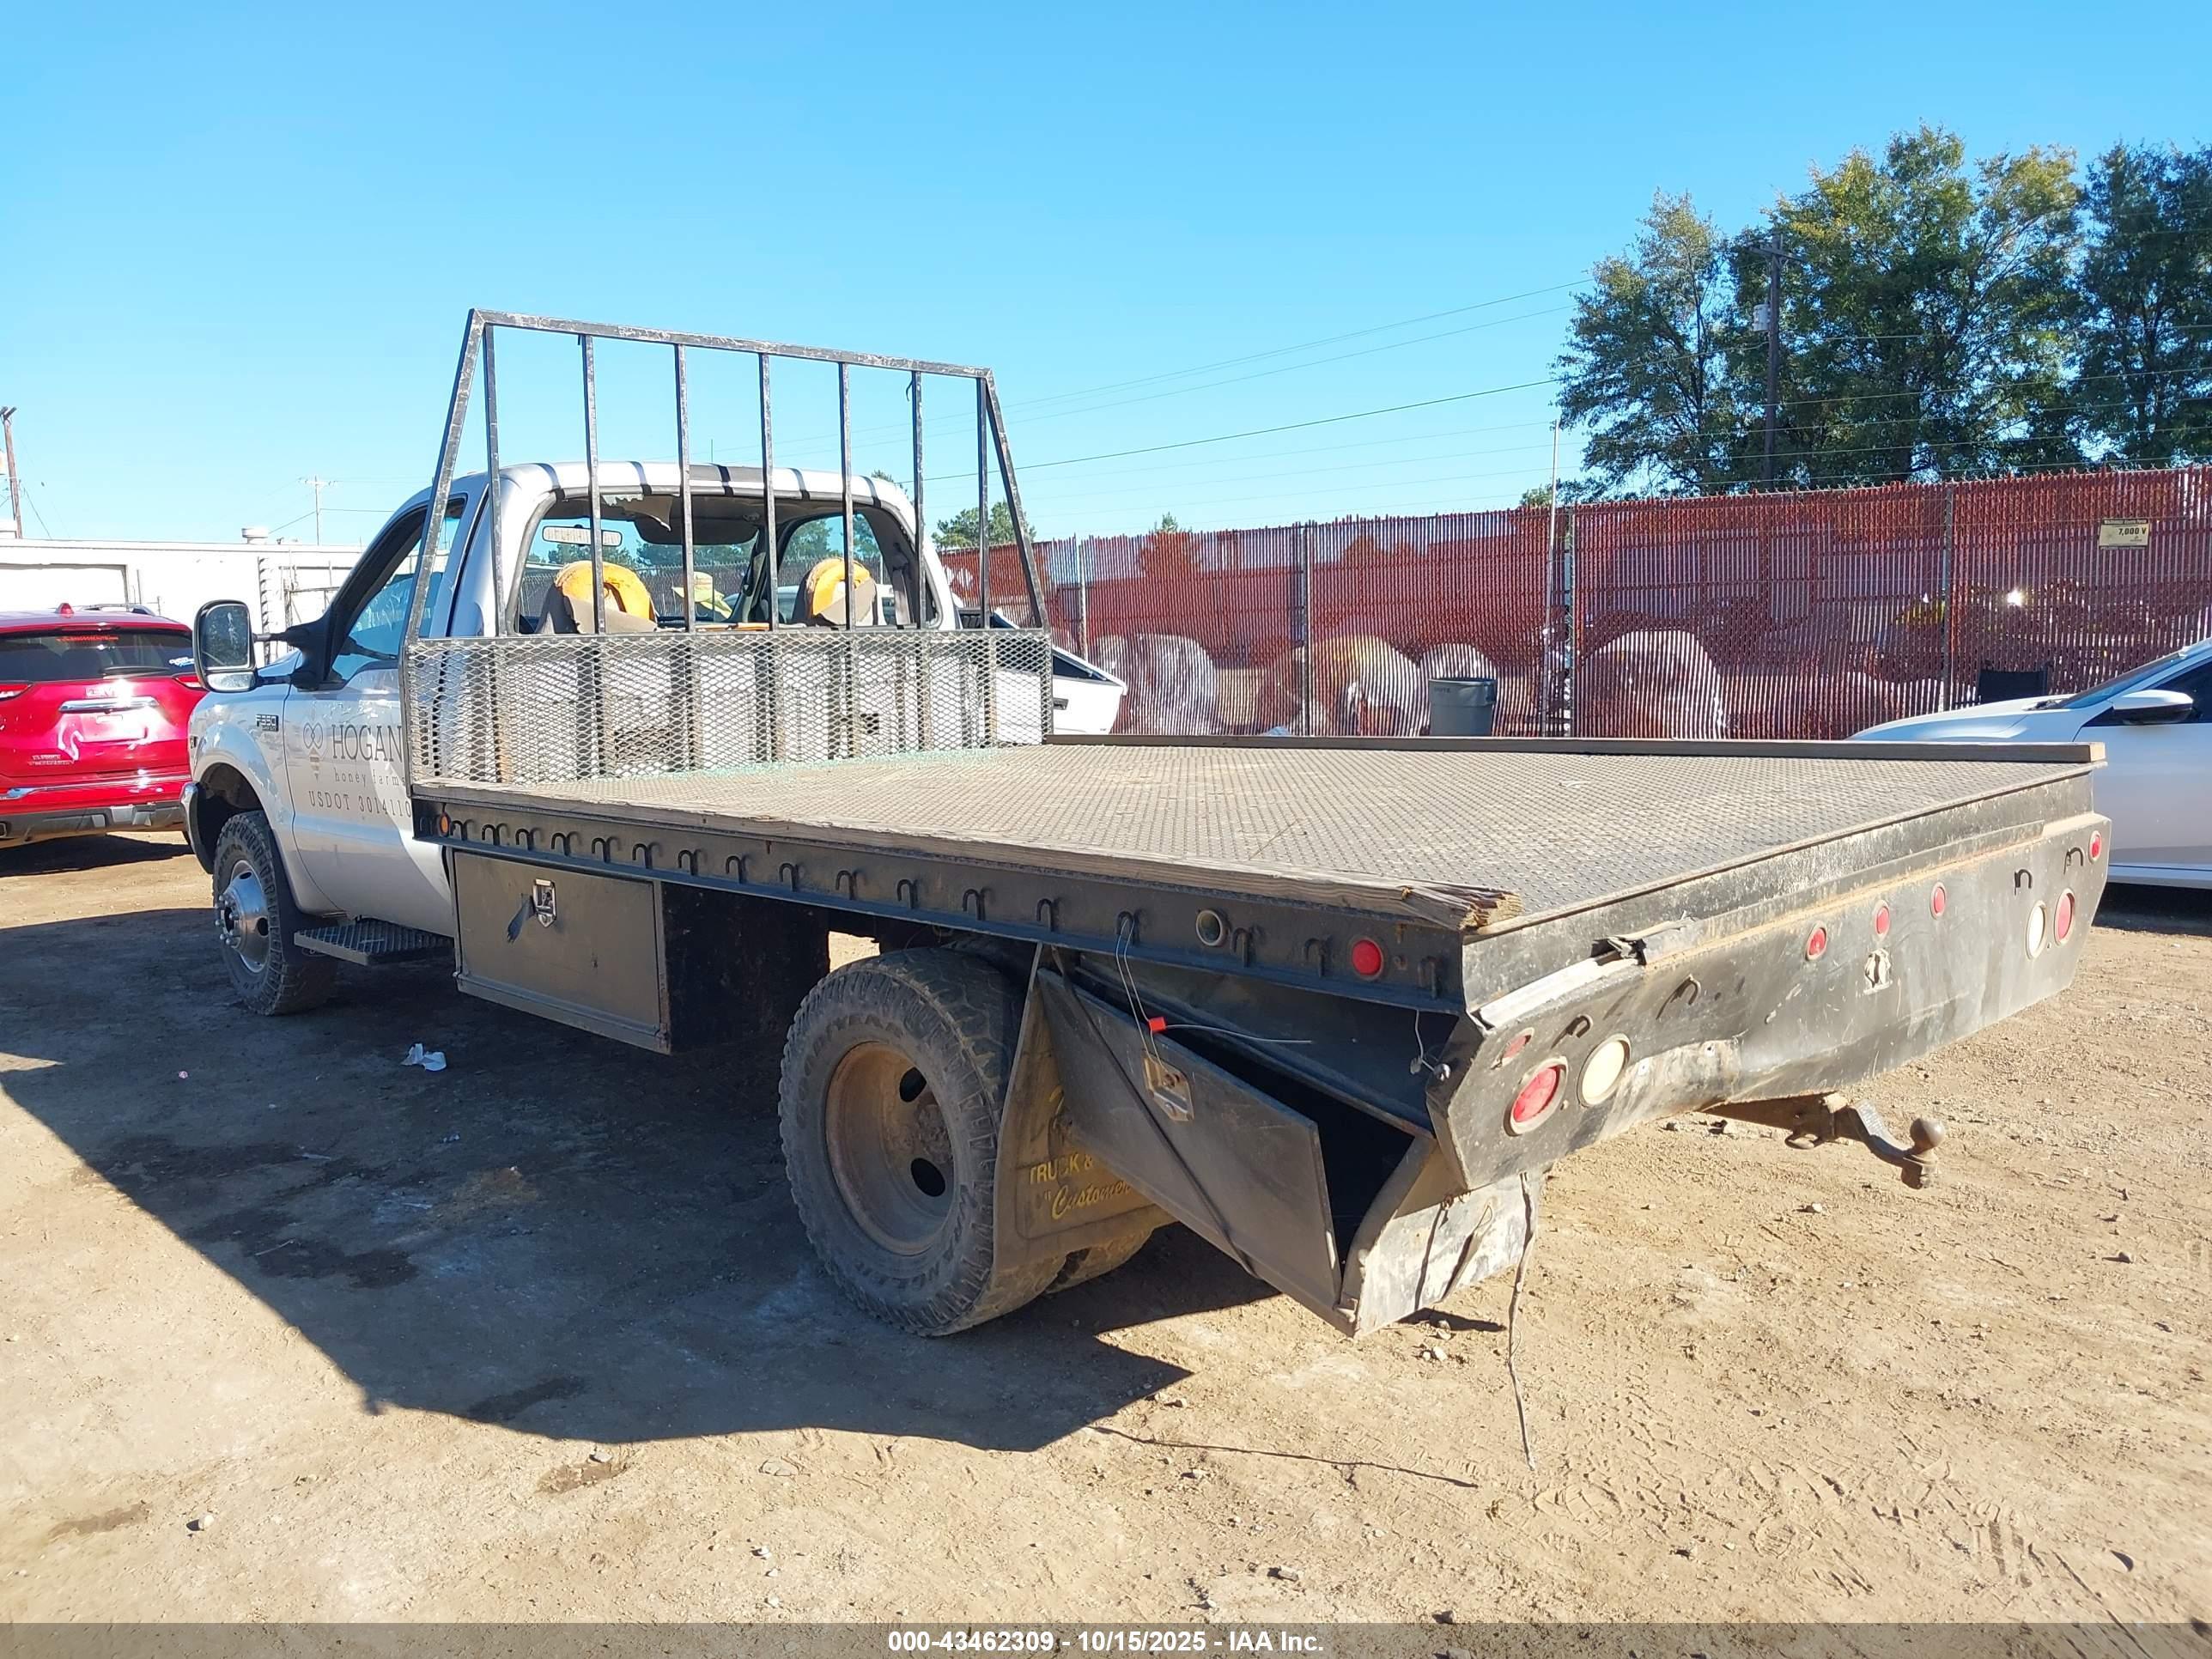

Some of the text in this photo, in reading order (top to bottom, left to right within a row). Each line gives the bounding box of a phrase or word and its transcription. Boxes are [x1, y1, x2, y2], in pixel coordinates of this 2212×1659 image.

[2118, 527, 2140, 536] 7,000
[331, 724, 403, 763] HOGAN
[334, 767, 406, 787] honey farms
[309, 790, 412, 818] USDOT 3014110
